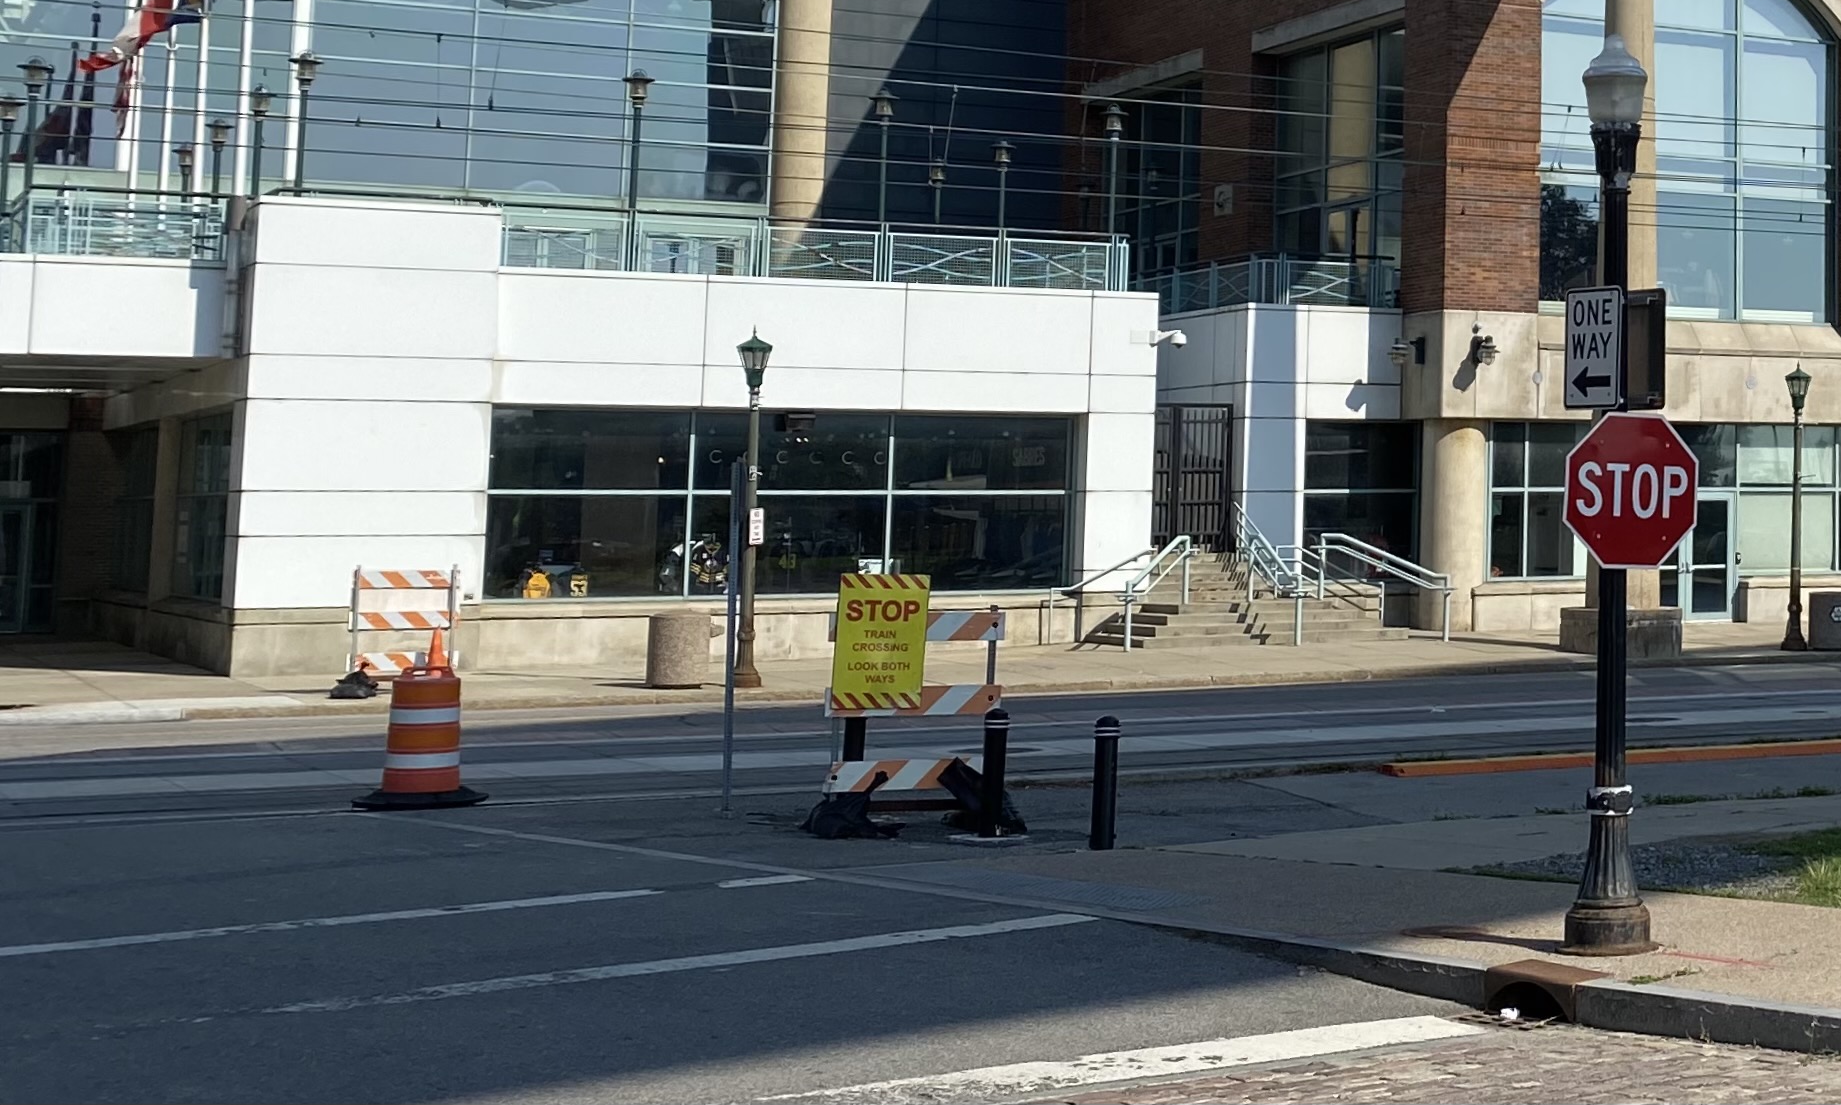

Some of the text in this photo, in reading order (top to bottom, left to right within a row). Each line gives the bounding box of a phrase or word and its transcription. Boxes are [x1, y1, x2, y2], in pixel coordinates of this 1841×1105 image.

[1573, 298, 1613, 327] ONE
[1572, 332, 1613, 360] WAY
[1575, 460, 1689, 520] STOP
[845, 599, 921, 622] STOP
[864, 630, 897, 639] TRAIN
[852, 643, 909, 652] CROSSING
[847, 661, 911, 671] LOOK BOTH
[864, 675, 895, 684] WAYS
